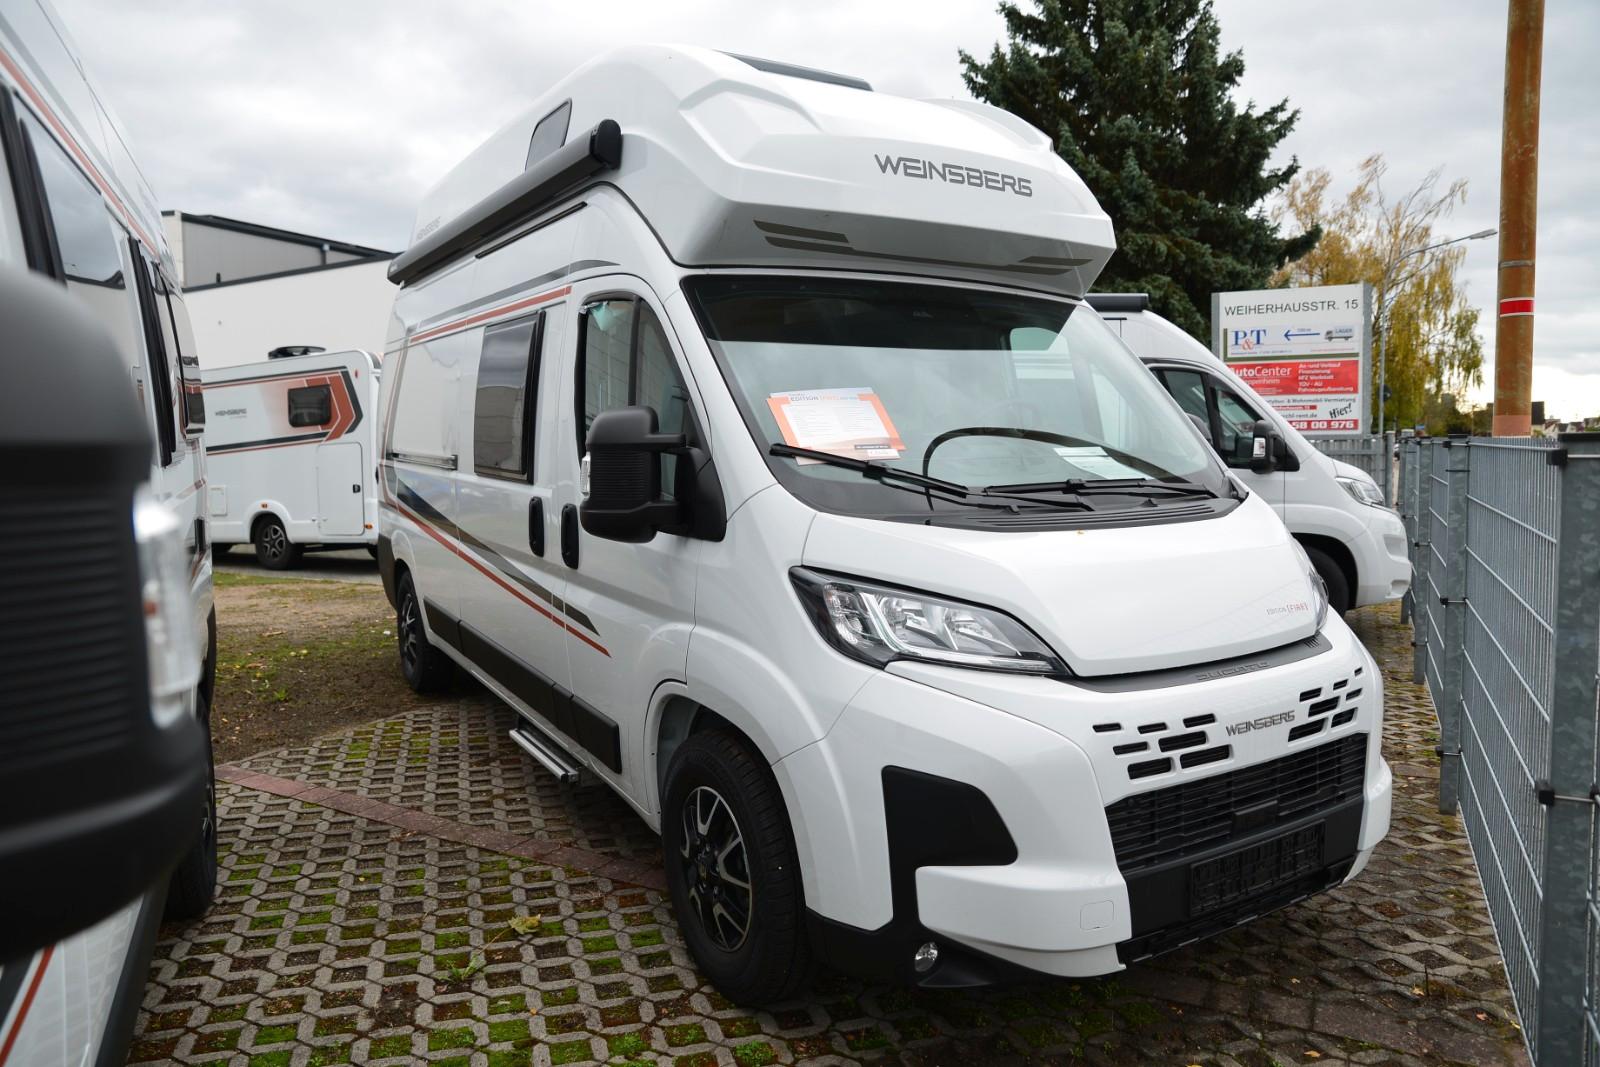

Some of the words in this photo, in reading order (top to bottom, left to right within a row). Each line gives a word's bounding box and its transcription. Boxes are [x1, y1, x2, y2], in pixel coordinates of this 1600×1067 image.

[874, 153, 1033, 197] WEINSBERG
[1224, 300, 1340, 316] WEIHERHAUSSTR.
[1344, 299, 1359, 310] 15
[1231, 328, 1267, 350] P&T
[1328, 402, 1352, 419] Hier!
[1330, 420, 1354, 429] 976
[1225, 710, 1296, 737] WEINSBERG
